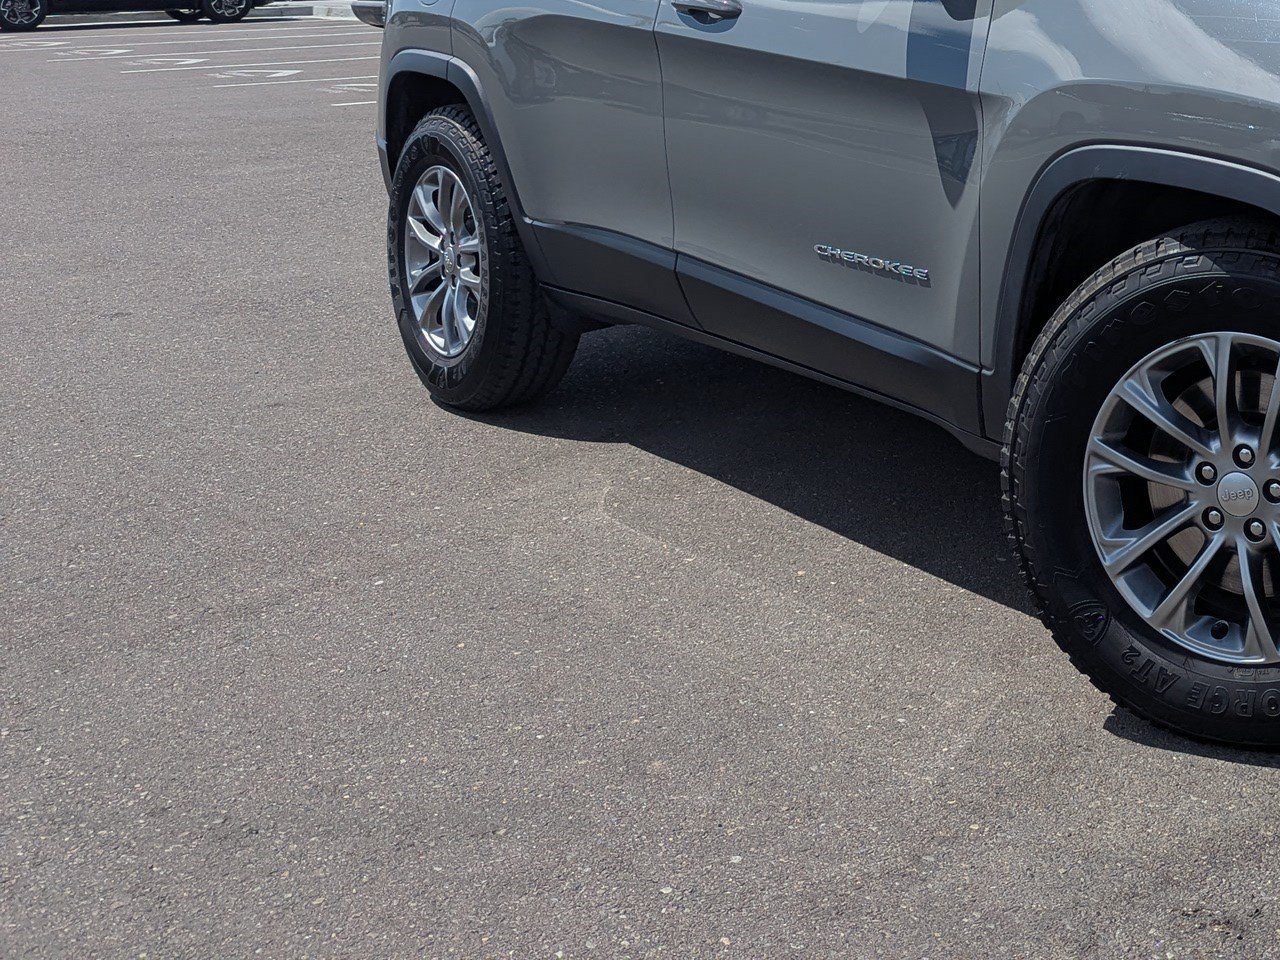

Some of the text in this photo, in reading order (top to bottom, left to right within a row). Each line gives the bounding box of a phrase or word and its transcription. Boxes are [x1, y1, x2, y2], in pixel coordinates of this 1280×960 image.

[813, 244, 929, 280] CHEROKEE
[1221, 488, 1255, 502] Jeep
[1121, 643, 1182, 695] AT2
